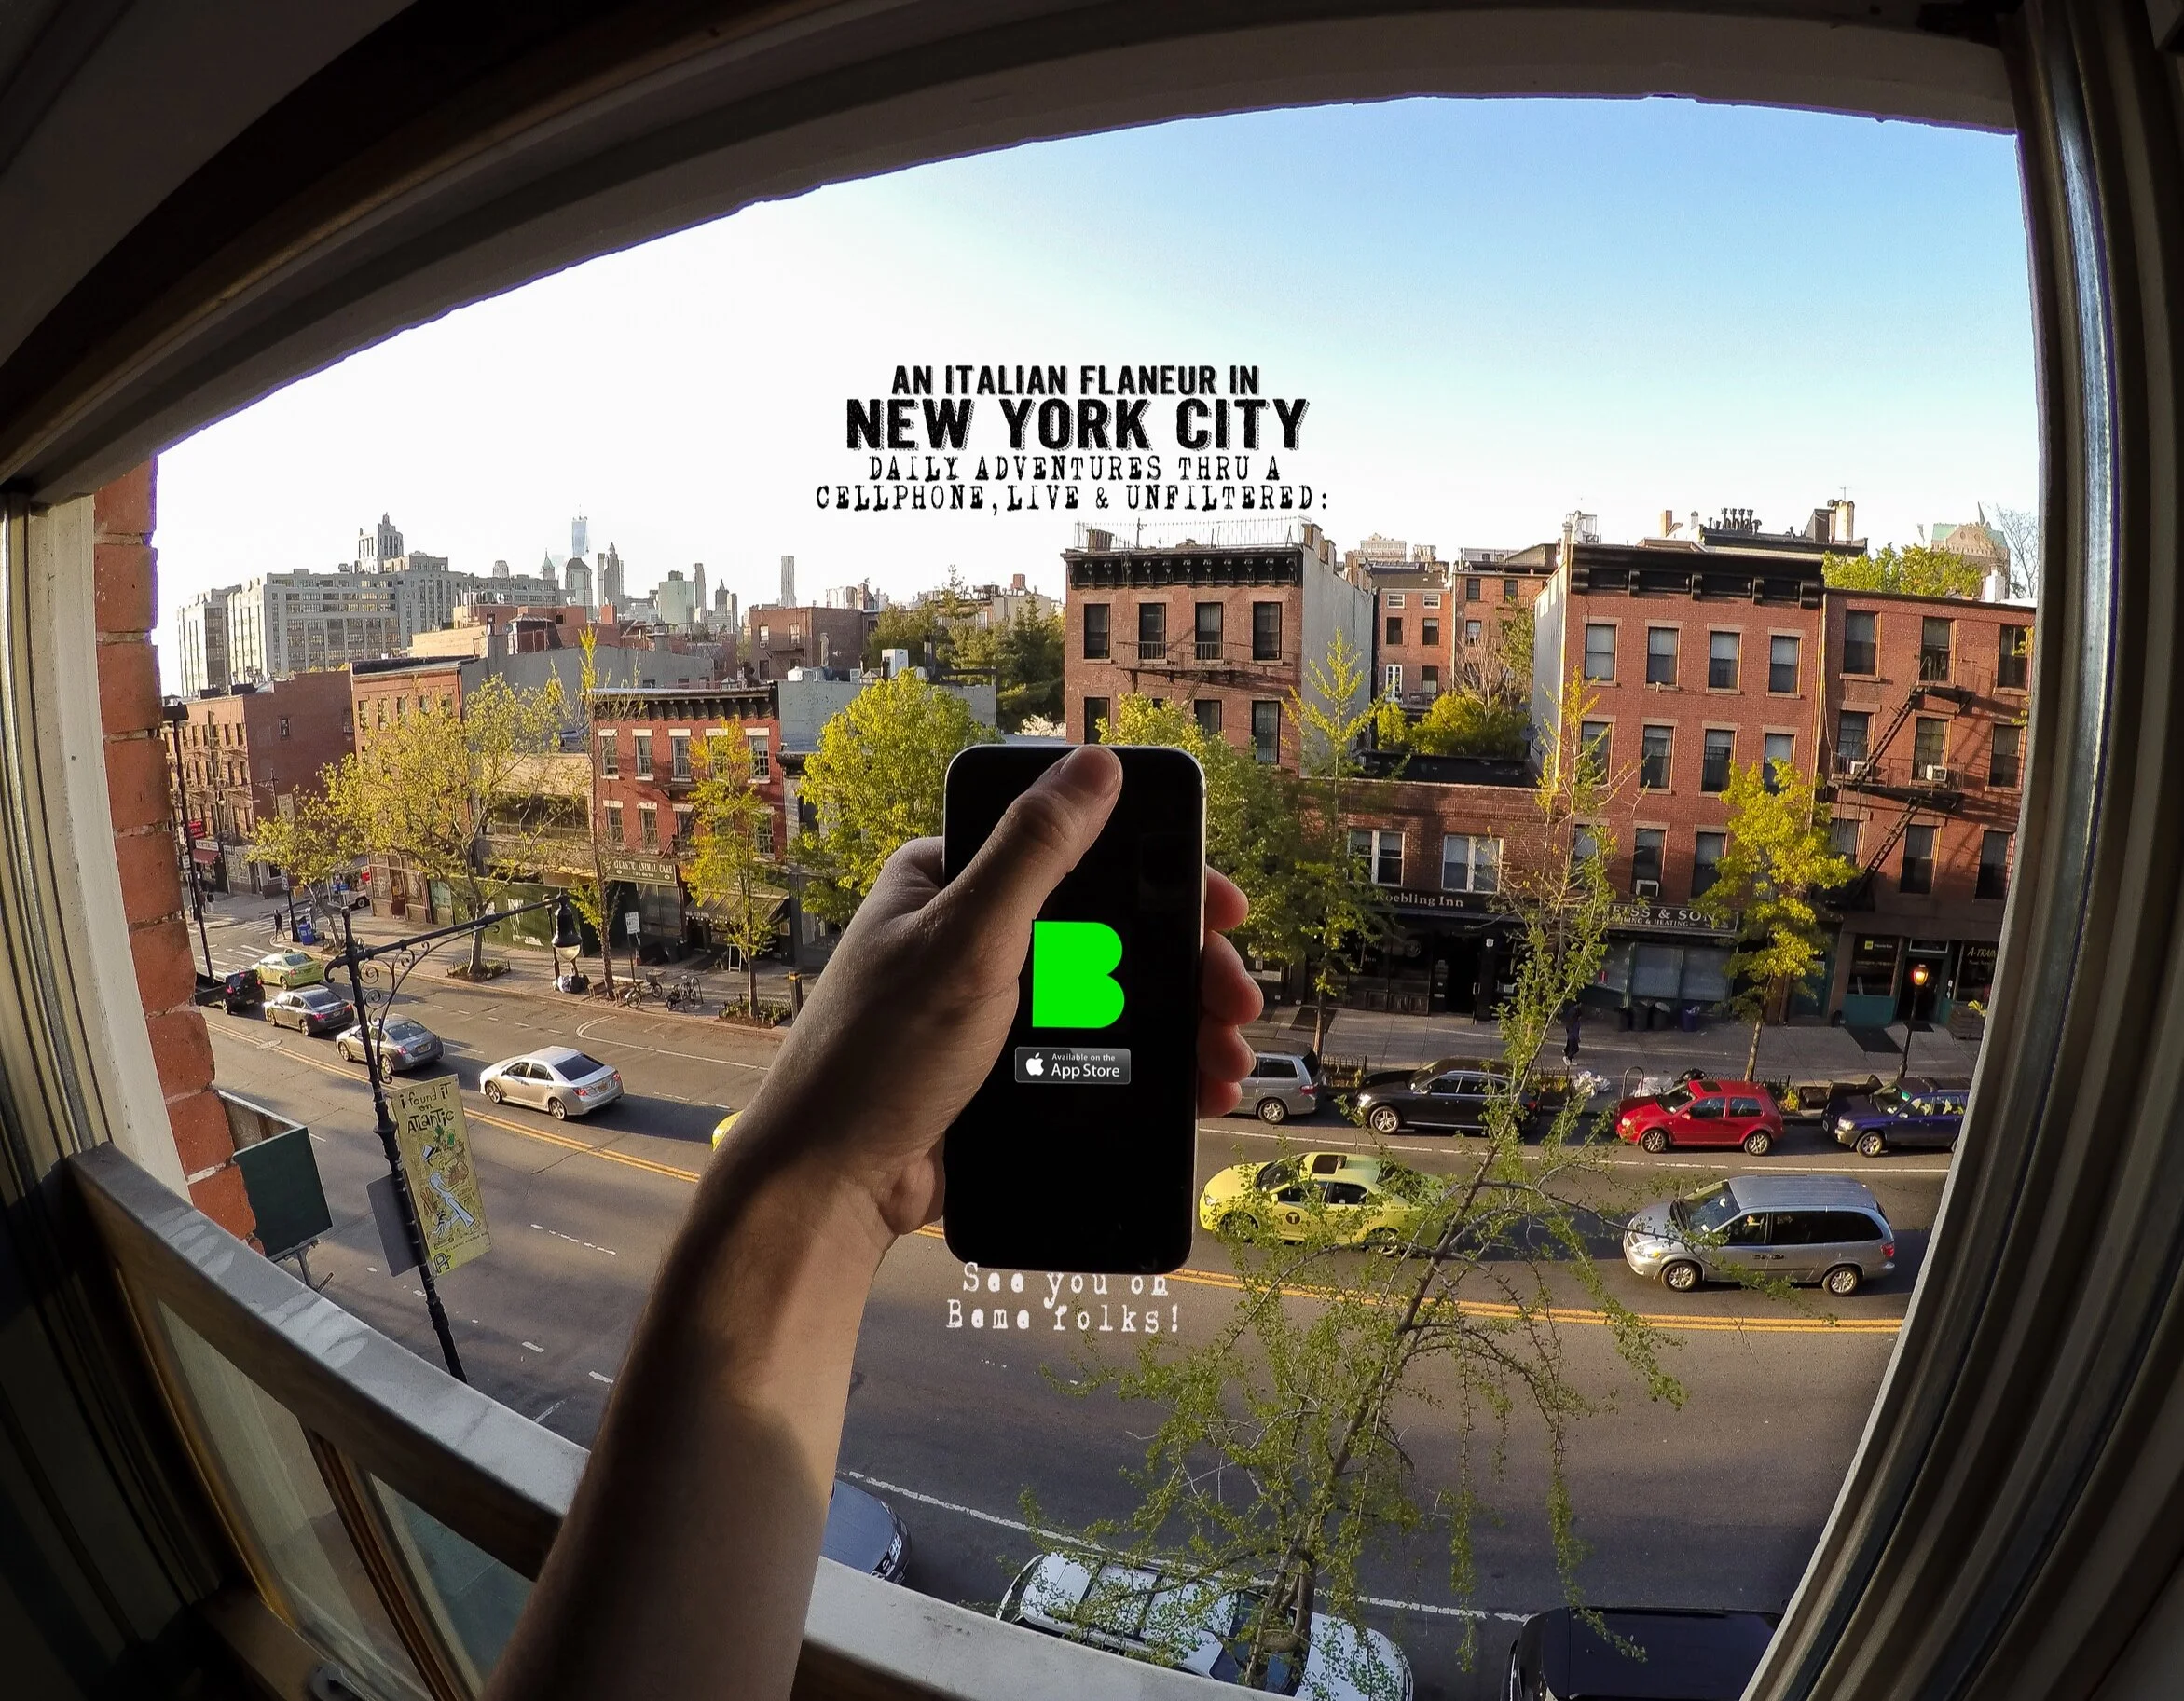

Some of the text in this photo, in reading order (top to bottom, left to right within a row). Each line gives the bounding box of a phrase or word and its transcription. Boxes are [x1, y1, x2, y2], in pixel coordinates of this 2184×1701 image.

[659, 864, 673, 873] CARE
[1440, 896, 1463, 908] Inn
[1658, 908, 1671, 919] &
[1654, 918, 1689, 927] HEATING
[1033, 921, 1124, 1028] B
[1051, 1053, 1088, 1062] Available
[1051, 1063, 1120, 1079] App Store
[408, 1086, 437, 1106] found
[419, 1104, 433, 1112] on
[1288, 1213, 1298, 1224] T
